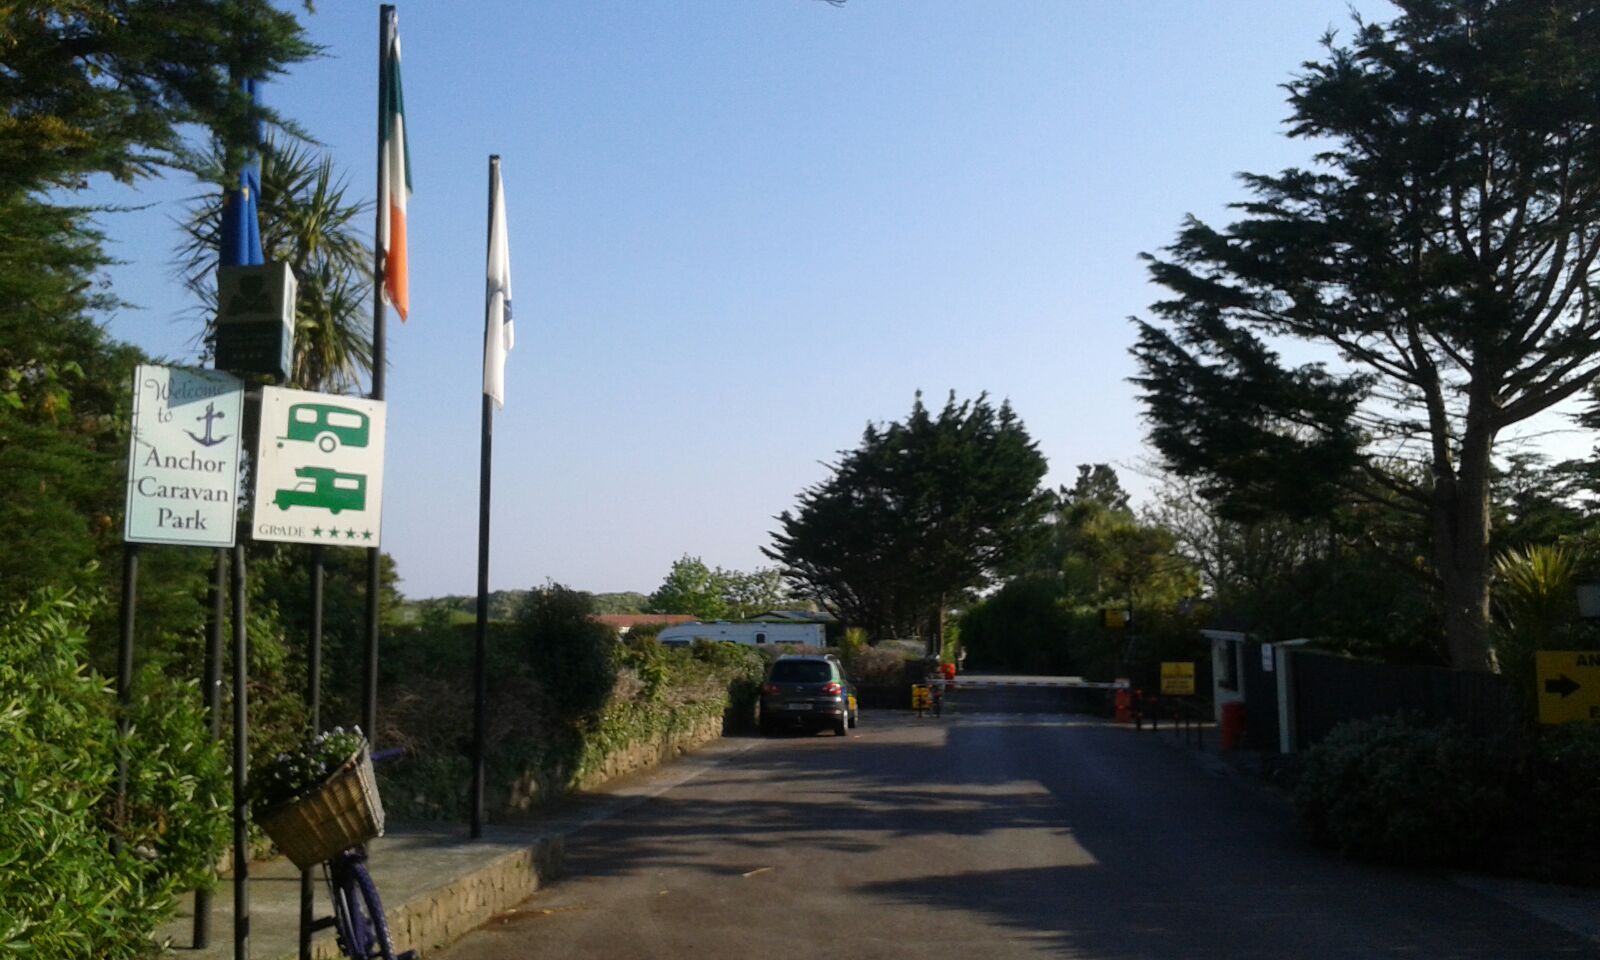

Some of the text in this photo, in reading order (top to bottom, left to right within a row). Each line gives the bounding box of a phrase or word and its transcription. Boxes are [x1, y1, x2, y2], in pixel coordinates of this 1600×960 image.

[145, 377, 224, 400] Welcome
[158, 406, 173, 423] to
[144, 447, 226, 473] Anchor
[137, 476, 229, 502] Caravan
[157, 508, 208, 531] Park
[259, 523, 305, 537] GRADE
